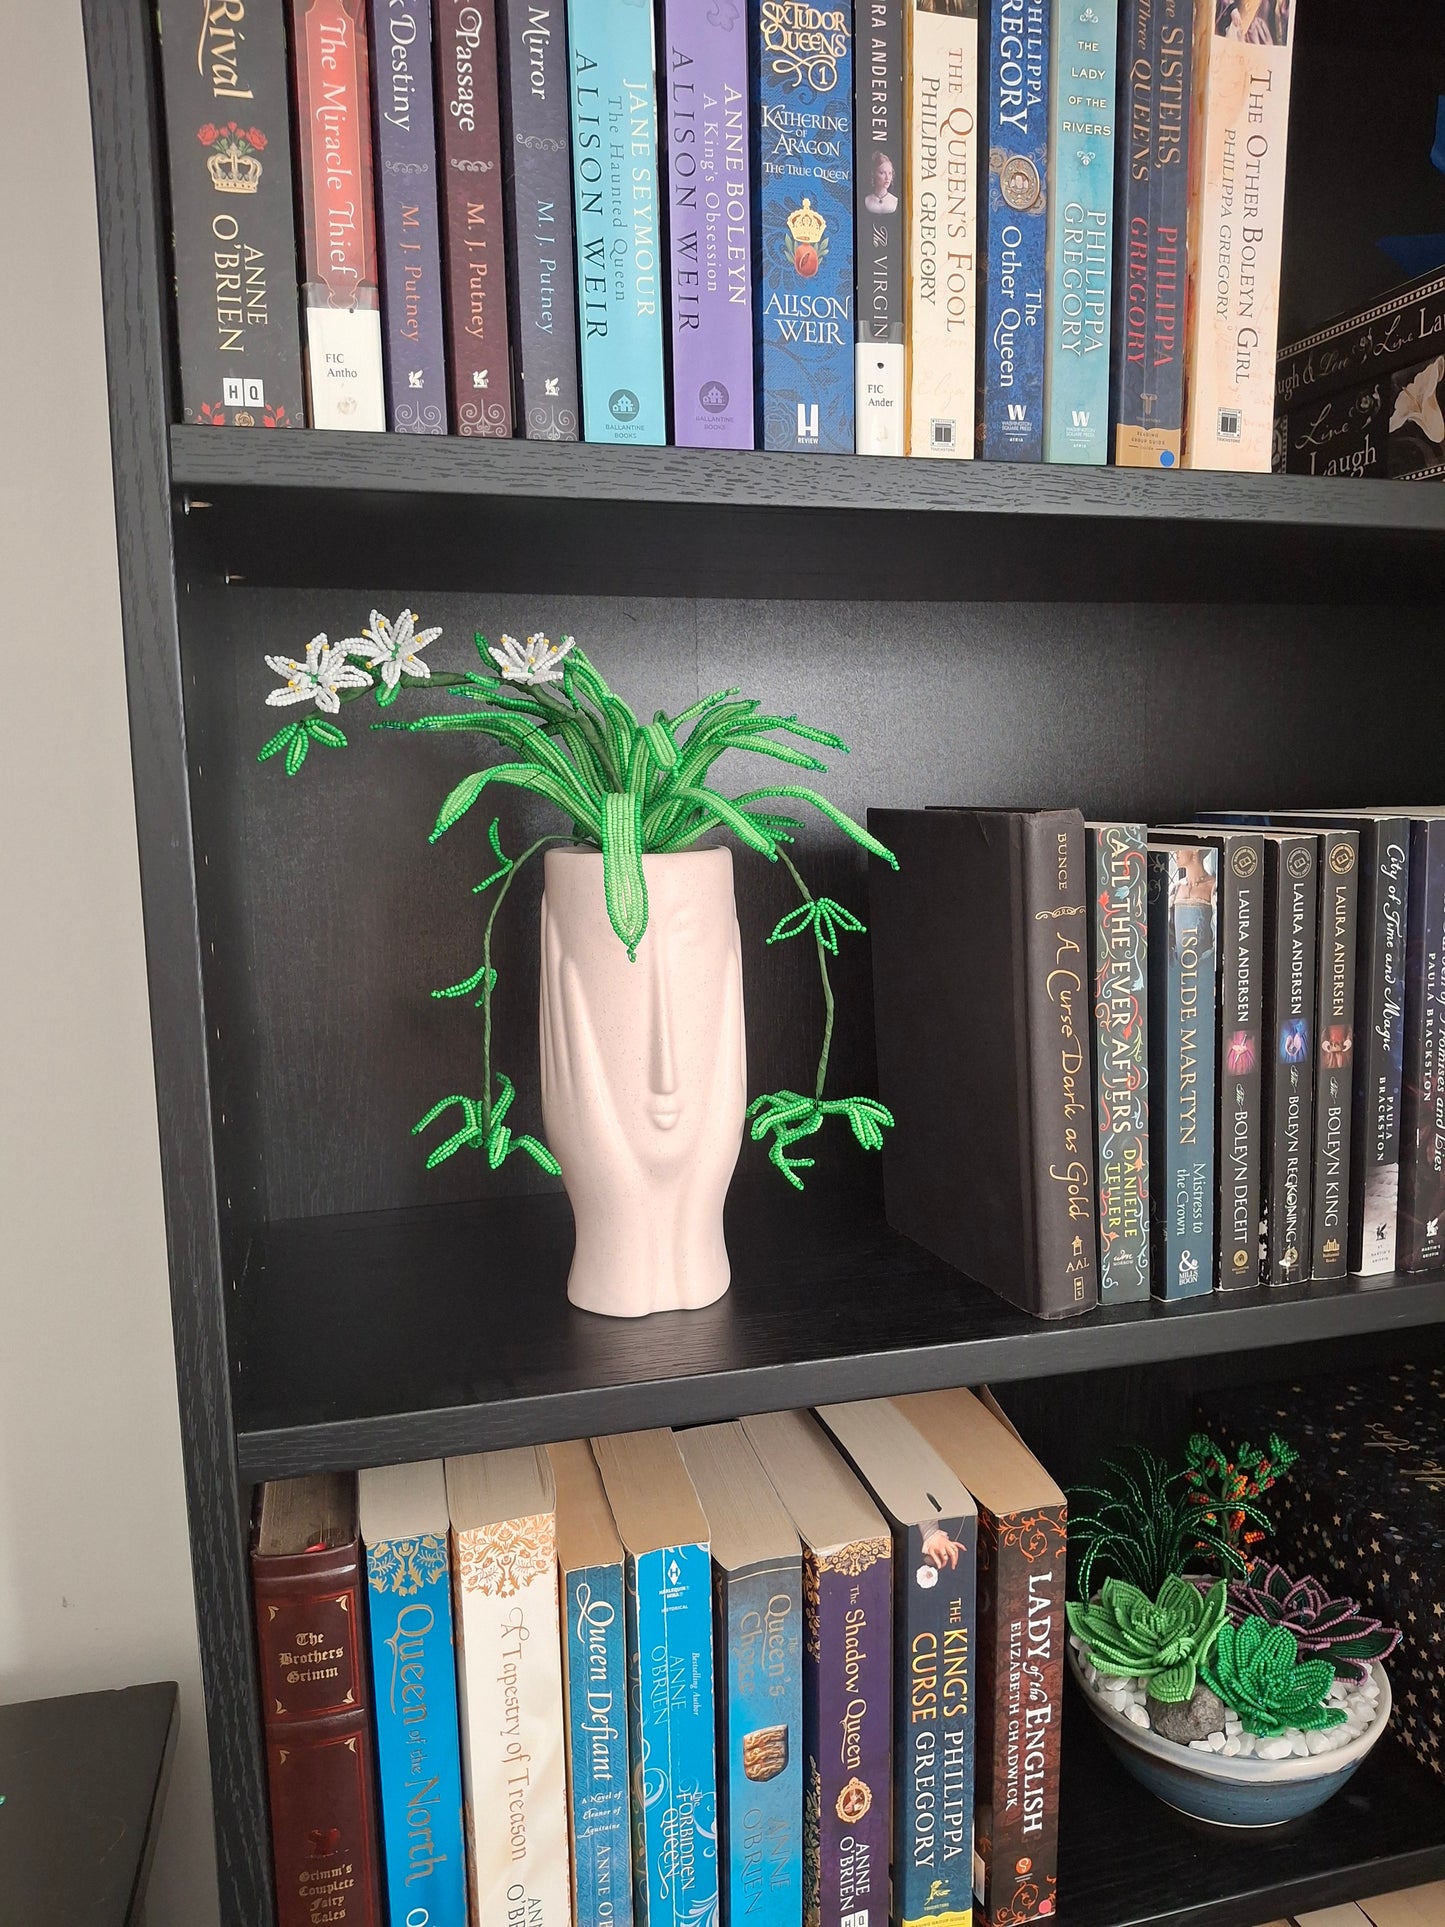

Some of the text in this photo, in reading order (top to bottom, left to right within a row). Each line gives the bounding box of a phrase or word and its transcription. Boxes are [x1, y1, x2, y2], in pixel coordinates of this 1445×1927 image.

[198, 0, 253, 99] Rival
[384, 14, 417, 132] Destiny
[450, 6, 483, 132] Passage
[522, 6, 551, 99] Mirror
[1071, 67, 1106, 80] LADY
[1078, 41, 1099, 52] THE
[1062, 121, 1112, 137] RIVERS
[1068, 95, 1107, 109] OF THE
[316, 17, 359, 279] The Miracle Thief
[772, 134, 841, 157] ARAGON
[575, 49, 609, 342] ALISON WEIR
[607, 96, 629, 302] The Haunted Queen
[623, 79, 656, 317] JANE SEYMOUR
[672, 46, 701, 333] ALISON WEIR
[700, 94, 721, 293] A King's Obsession
[724, 84, 747, 306] ANNE BOLEYN
[920, 76, 941, 307] PHILIPPA GREGORY
[939, 48, 974, 333] THE QUEEN'S FOOL
[1215, 128, 1237, 320] PHILIPPA GREGORY
[1235, 69, 1272, 385] THE OTHER BOLEYN GIRL
[212, 214, 245, 353] O'BRIEN
[243, 243, 268, 325] ANNE
[400, 205, 423, 343] M. J. Putney
[465, 202, 488, 339] M. J. Putney
[535, 200, 557, 335] M. J. Putney
[763, 293, 850, 320] ALISON
[994, 225, 1020, 388] Other Queen
[1024, 289, 1043, 327] The
[1061, 202, 1084, 356] GREGORY
[1083, 211, 1107, 353] PHILIPPA
[1126, 217, 1151, 368] GREGORY
[1153, 226, 1179, 367] PHILIPPA
[325, 353, 345, 364] FIC
[327, 368, 358, 379] Antho
[774, 319, 846, 345] WEIR
[605, 424, 645, 432] BALLANTINE
[867, 384, 884, 394] FIC
[868, 397, 894, 407] Ander
[614, 432, 637, 440] BOOKS
[797, 437, 819, 445] REVIEW
[1309, 434, 1377, 478] Laugh
[1057, 832, 1067, 890] BUNCE
[1238, 889, 1250, 941] LAURA
[1292, 882, 1304, 934] LAURA
[1334, 886, 1347, 937] LAURA
[1375, 844, 1406, 1051] City of Time and Magic
[1111, 838, 1132, 1134] ALL THE EVER AFTERS
[1237, 945, 1249, 1022] ANDERSEN
[1291, 939, 1303, 1015] ANDERSEN
[1333, 941, 1346, 1016] ANDERSEN
[1179, 927, 1199, 1145] ISOLDE MARTYN
[1423, 952, 1437, 1101] PAULA BRACKSTON
[1046, 932, 1090, 1221] A Curse Dark as Gold
[1289, 1065, 1299, 1090] The
[1377, 1077, 1386, 1161] BRACKSTON
[1385, 1096, 1394, 1140] PAULA
[1230, 1083, 1249, 1243] The BOLEYN DECEIT
[1284, 1096, 1299, 1156] BOLEYN
[1322, 1076, 1341, 1227] The BOLEYN KING
[1108, 1163, 1122, 1228] TELLER
[1123, 1150, 1137, 1238] DANIELLE
[1176, 1169, 1190, 1236] the Crown
[1192, 1163, 1206, 1233] Mistress to
[278, 1646, 344, 1667] Brothers
[286, 1667, 339, 1684] Grimm
[295, 1632, 324, 1646] The
[383, 1603, 436, 1726] Queen
[732, 1611, 762, 1696] Choice
[761, 1594, 792, 1697] Queen's
[840, 1585, 868, 1770] The Shadow Queen
[911, 1632, 937, 1723] CURSE
[943, 1597, 969, 1718] THE KING'S
[496, 1642, 527, 1737] Tapestry
[576, 1583, 619, 1781] Queen Defiant
[670, 1654, 687, 1711] ANNE
[691, 1652, 701, 1717] Bestselling Author
[1005, 1622, 1021, 1811] ELIZABETH CHADWICK
[1021, 1571, 1052, 1835] LADY of the ENGLISH
[408, 1730, 425, 1746] of
[409, 1749, 427, 1775] the
[503, 1743, 531, 1762] of
[404, 1775, 448, 1888] North
[509, 1767, 531, 1861] Treason
[912, 1731, 936, 1868] GREGORY
[942, 1730, 966, 1862] PHILIPPA
[596, 1844, 614, 1896] ANNE
[676, 1790, 696, 1891] FORBIDDEN
[768, 1818, 790, 1893] ANNE
[840, 1836, 855, 1912] O'BRIEN
[855, 1842, 871, 1896] ANNE
[298, 1877, 355, 1898] Complete
[309, 1895, 345, 1912] Fairy
[311, 1908, 346, 1925] Tales
